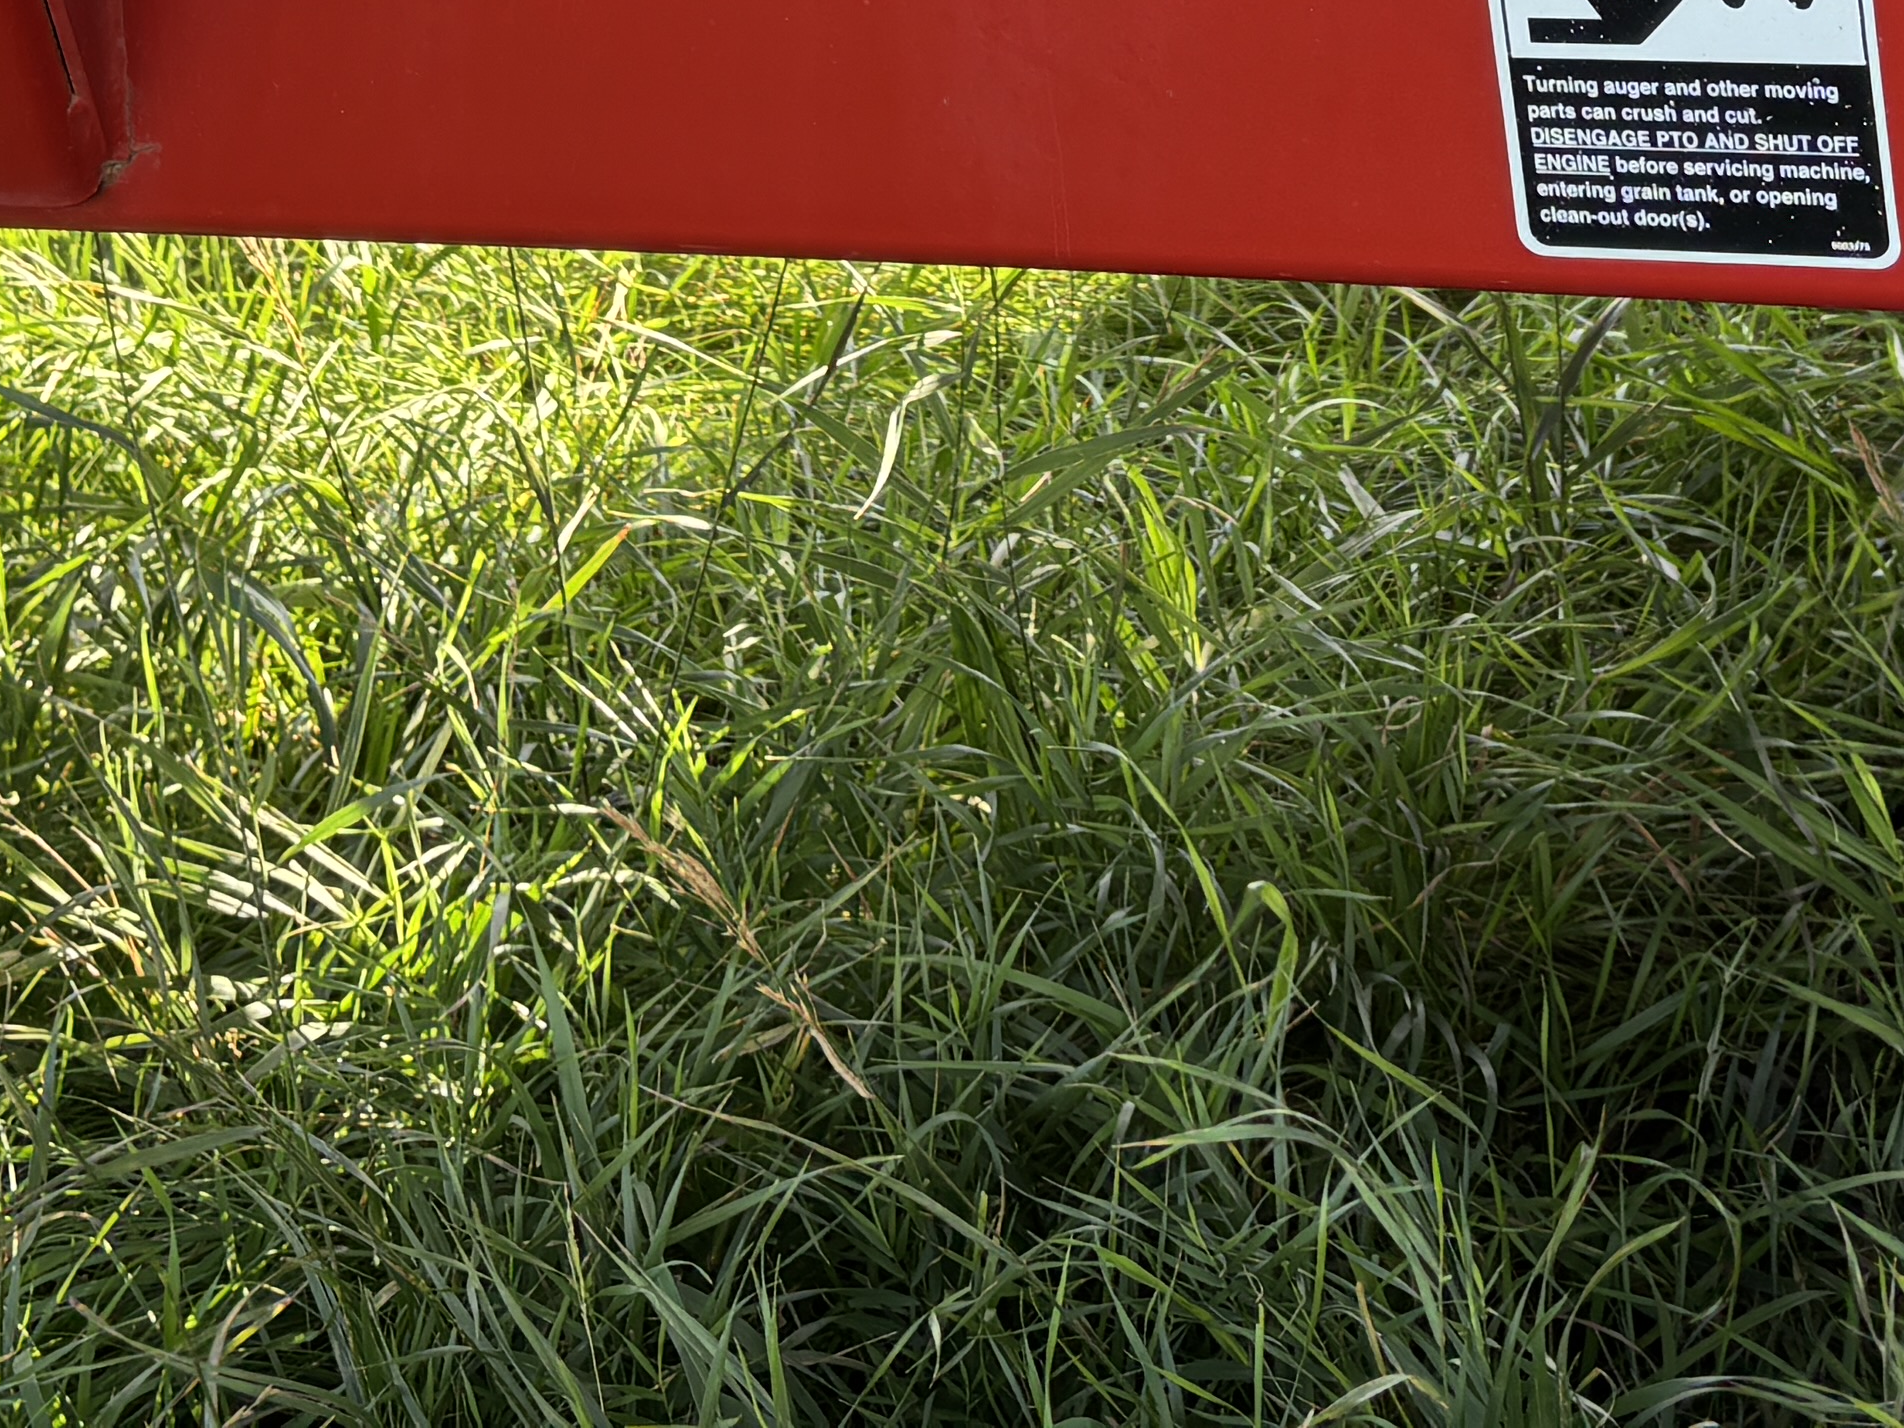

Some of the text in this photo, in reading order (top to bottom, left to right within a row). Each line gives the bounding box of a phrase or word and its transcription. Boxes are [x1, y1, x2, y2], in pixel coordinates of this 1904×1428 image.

[1522, 75, 1839, 103] Turning auger and other moving
[1527, 104, 1762, 124] parts can crush and cut.
[1530, 128, 1859, 154] DISENGAGE PTO AND SHUT OFF
[1534, 153, 1871, 183] ENGINE before servicing machine,
[1537, 182, 1838, 210] entering grain tank, or opening
[1540, 208, 1710, 231] clean-out door(s).
